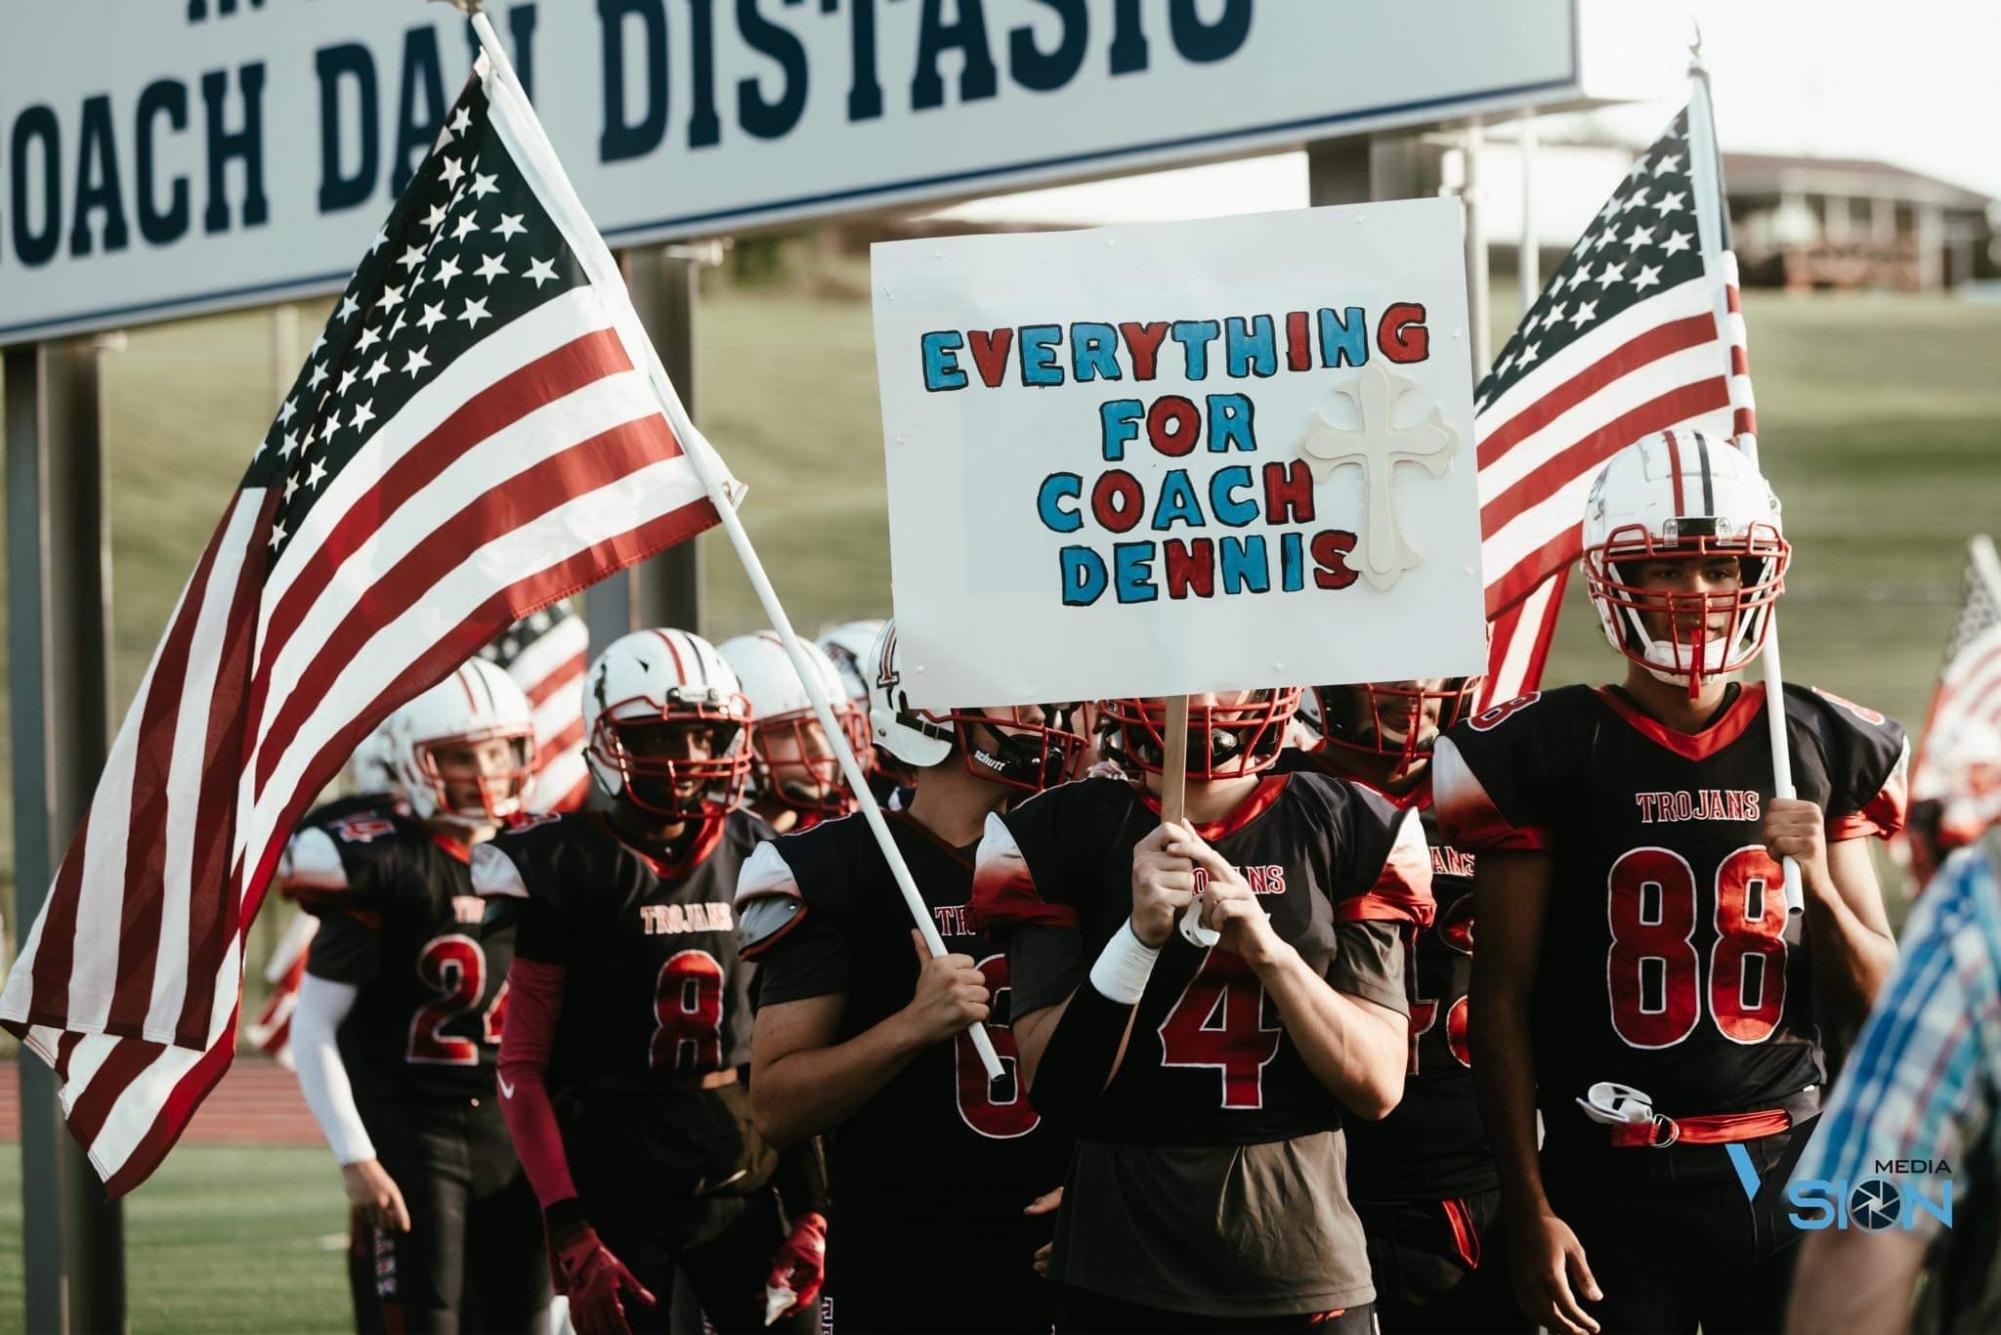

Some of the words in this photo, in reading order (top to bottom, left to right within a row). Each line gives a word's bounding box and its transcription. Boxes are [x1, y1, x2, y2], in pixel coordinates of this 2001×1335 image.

[0, 60, 270, 269] OACH
[920, 302, 1430, 392] EVERYTHING
[1099, 393, 1257, 462] FOR
[1036, 460, 1316, 533] COACH
[1059, 530, 1359, 607] DENNIS
[1636, 789, 1760, 824] TROJANS
[1607, 844, 1790, 1051] 88
[1158, 925, 1282, 1110] 4
